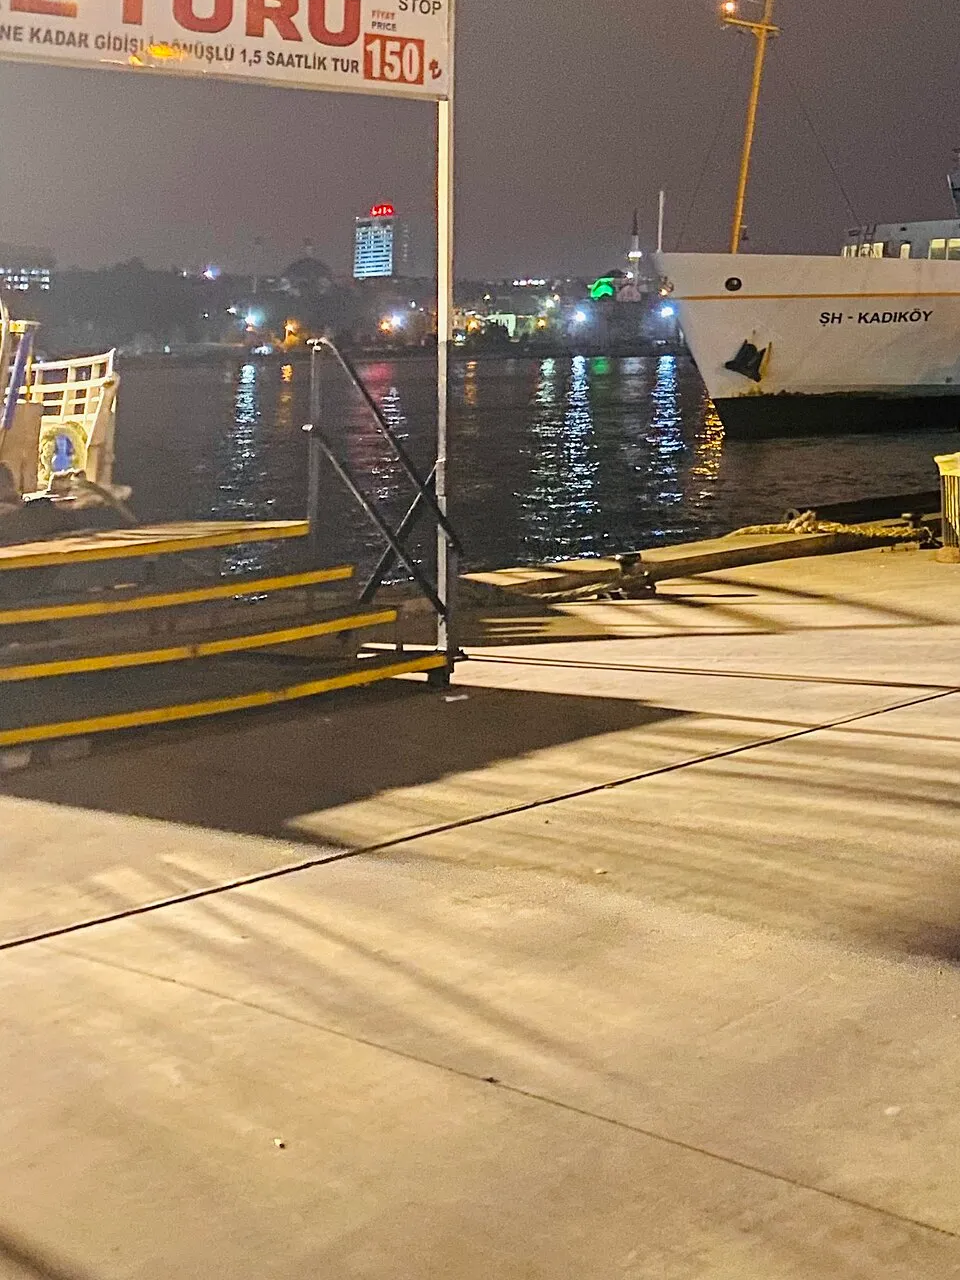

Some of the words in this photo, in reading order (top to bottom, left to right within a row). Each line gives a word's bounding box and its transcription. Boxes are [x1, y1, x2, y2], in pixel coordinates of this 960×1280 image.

[371, 21, 397, 32] PRICE
[29, 26, 89, 49] KADAR
[240, 48, 262, 66] 1,5
[266, 51, 327, 71] SAATLİK
[332, 57, 359, 73] TUR
[365, 38, 420, 83] 150
[858, 308, 934, 324] KADIKÖY
